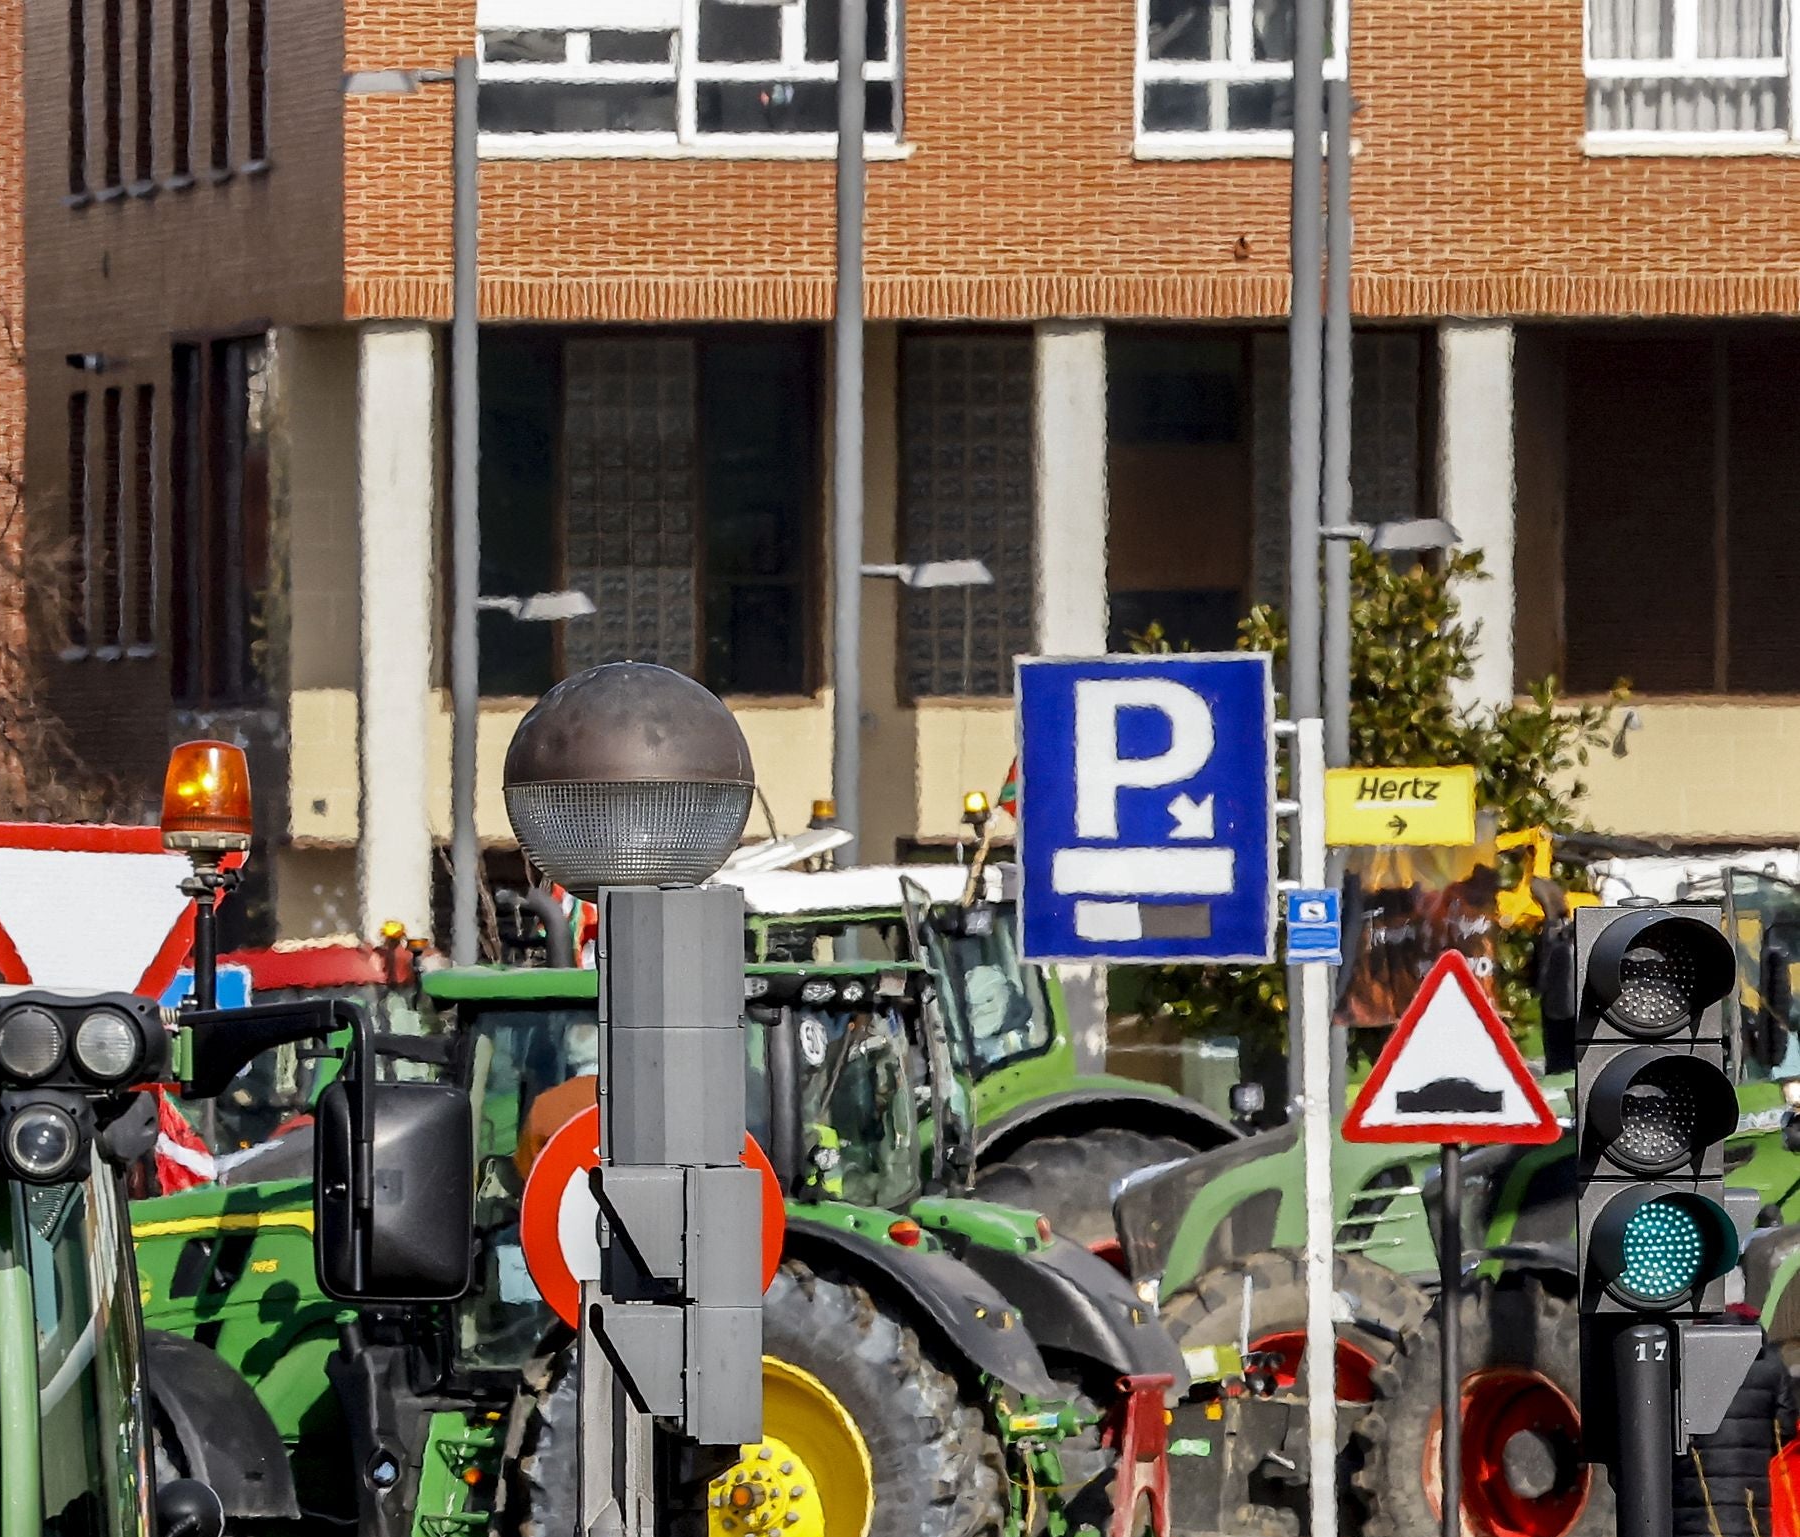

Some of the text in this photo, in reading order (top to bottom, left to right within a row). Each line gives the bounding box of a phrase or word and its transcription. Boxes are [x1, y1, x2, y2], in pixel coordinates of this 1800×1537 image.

[1075, 677, 1215, 838] P
[1356, 776, 1442, 801] Hertz
[1634, 1340, 1668, 1362] 17
